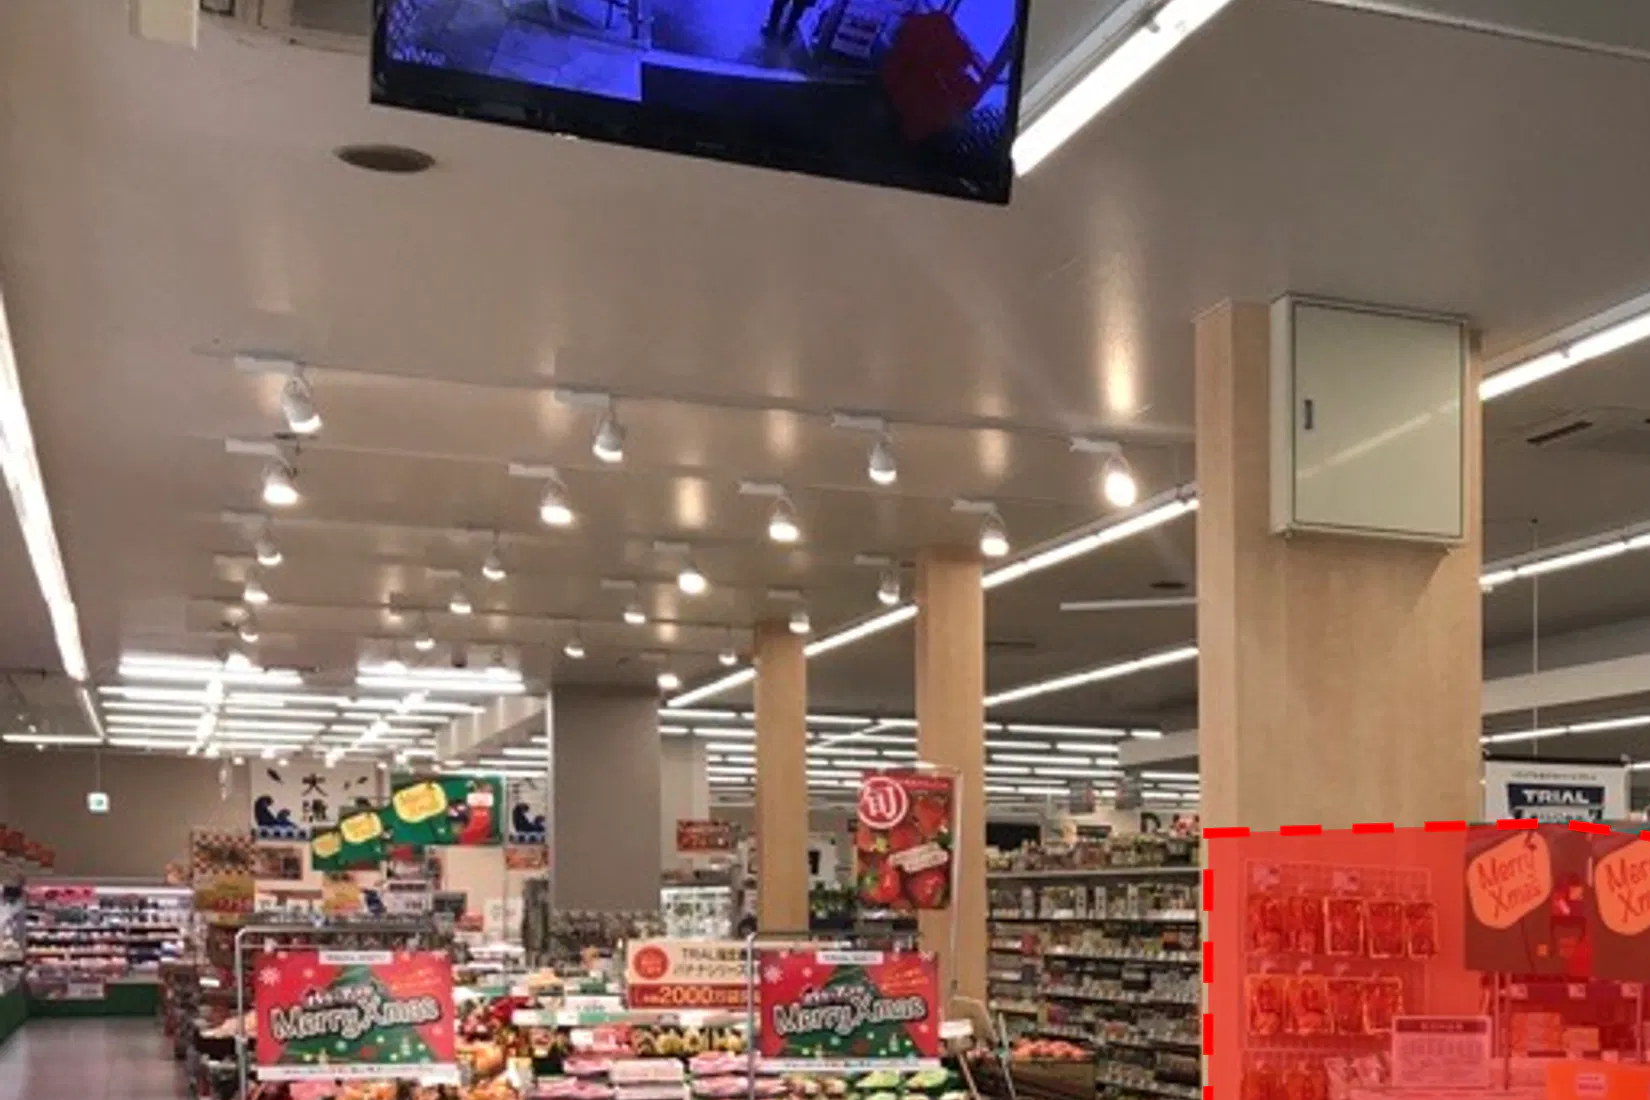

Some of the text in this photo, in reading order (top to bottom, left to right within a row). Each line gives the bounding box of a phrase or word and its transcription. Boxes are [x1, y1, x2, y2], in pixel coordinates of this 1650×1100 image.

[1522, 789, 1590, 804] TRIAL
[1477, 855, 1537, 888] Merry
[1489, 879, 1541, 918] Xmas
[270, 1003, 366, 1041] Merry
[356, 994, 441, 1030] Xmas
[773, 996, 926, 1035] Merry Xmas
